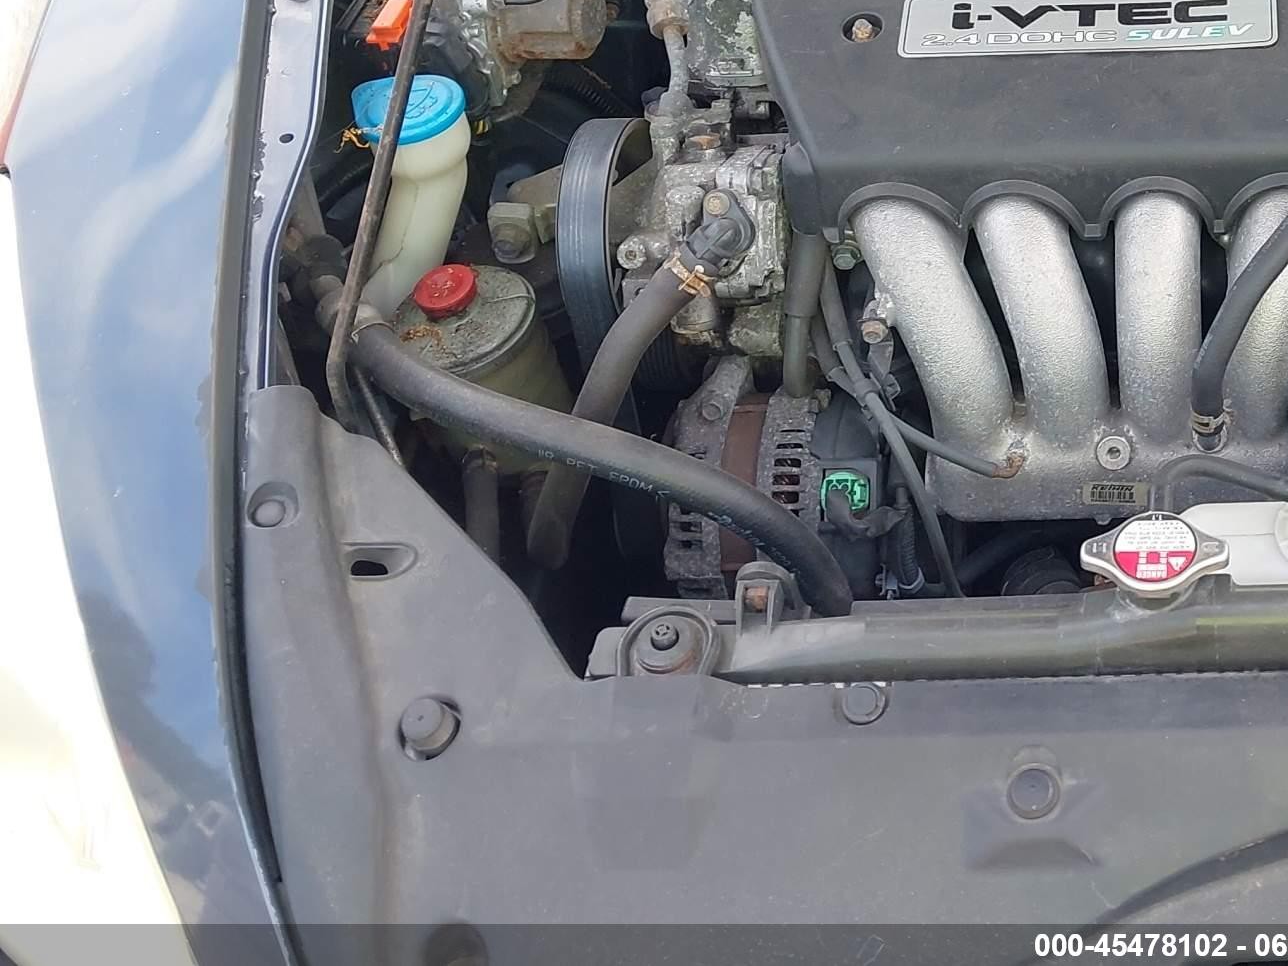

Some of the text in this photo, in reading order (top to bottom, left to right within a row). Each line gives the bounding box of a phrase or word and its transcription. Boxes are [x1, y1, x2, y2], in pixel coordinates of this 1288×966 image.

[951, 0, 1228, 30] i-VTEC
[920, 23, 1256, 47] 2.4 DOHC SULEV
